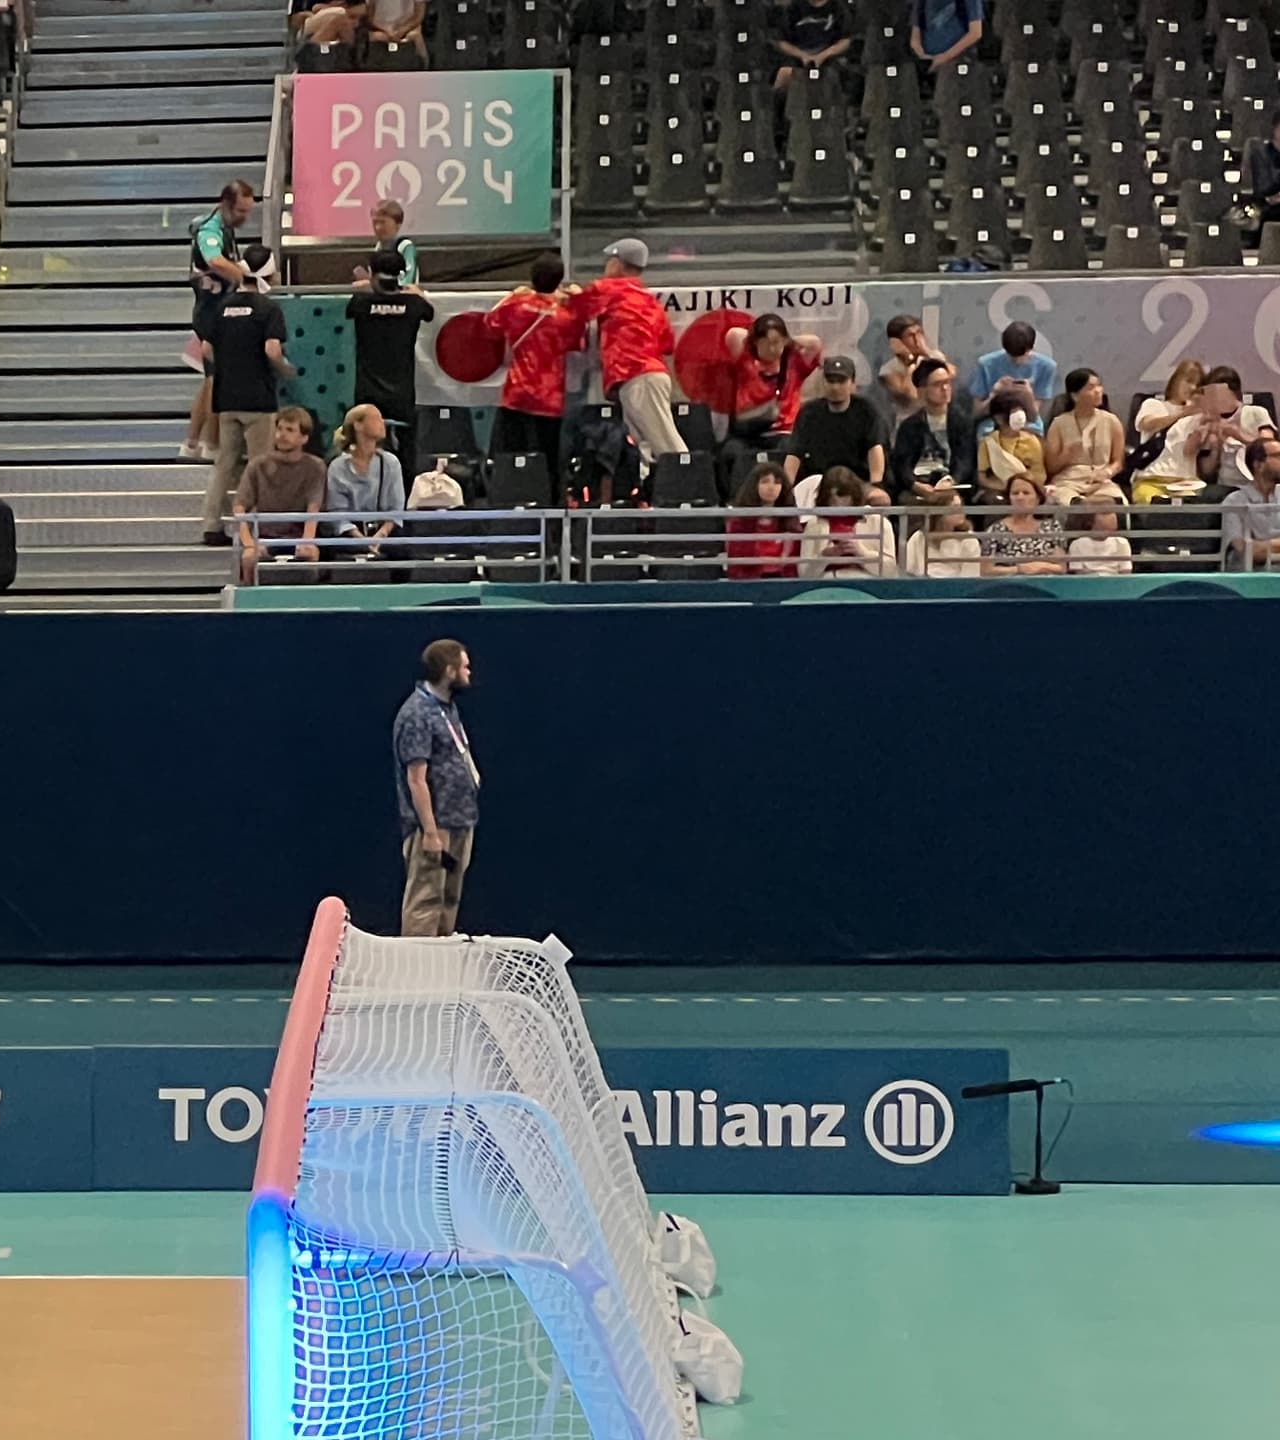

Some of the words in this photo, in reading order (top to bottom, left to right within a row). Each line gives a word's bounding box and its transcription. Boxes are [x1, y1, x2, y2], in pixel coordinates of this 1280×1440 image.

[777, 285, 853, 308] KOJI
[158, 1086, 272, 1143] TO
[608, 1090, 846, 1147] Allianz
